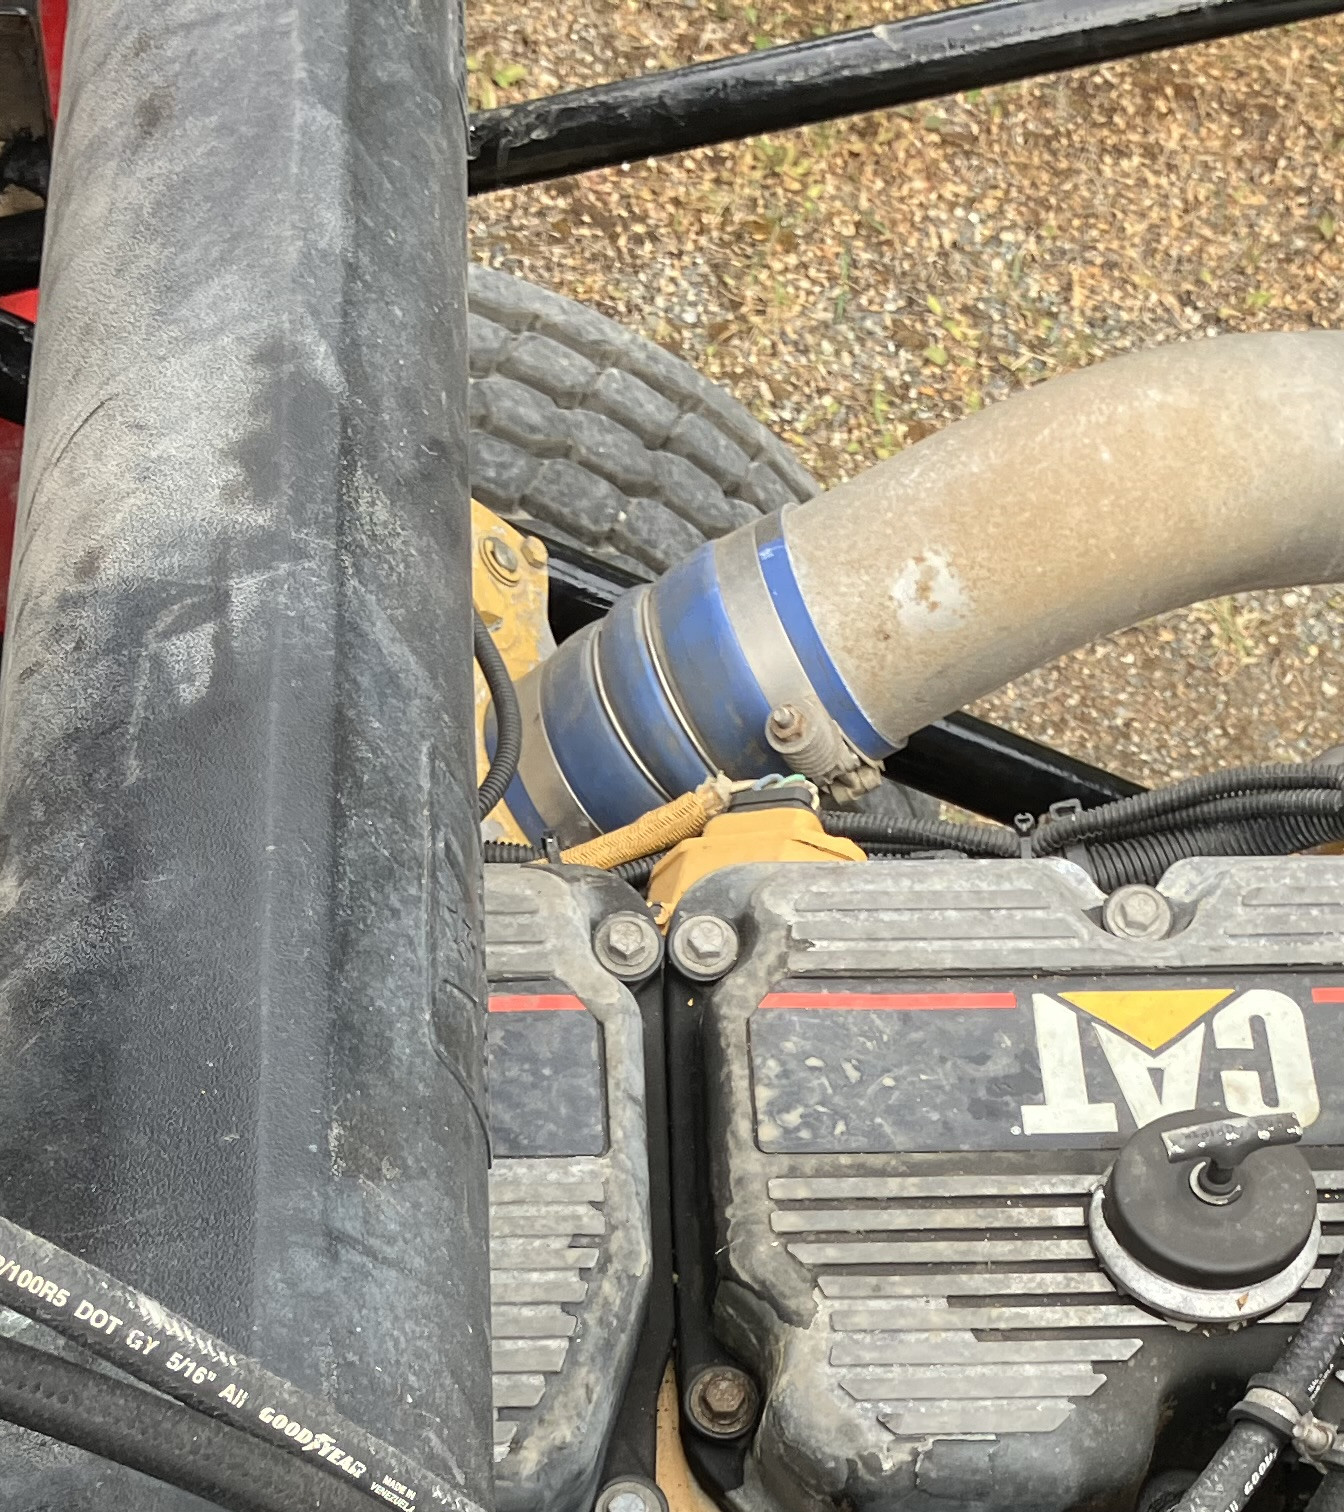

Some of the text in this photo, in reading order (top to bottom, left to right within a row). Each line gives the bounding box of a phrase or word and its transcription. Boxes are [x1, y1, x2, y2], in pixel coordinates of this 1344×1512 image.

[1021, 988, 1321, 1135] CAT
[73, 1299, 124, 1336] DOT
[125, 1329, 161, 1356] GY
[164, 1351, 218, 1385] 5/16"
[258, 1406, 368, 1480] GOODYEAR
